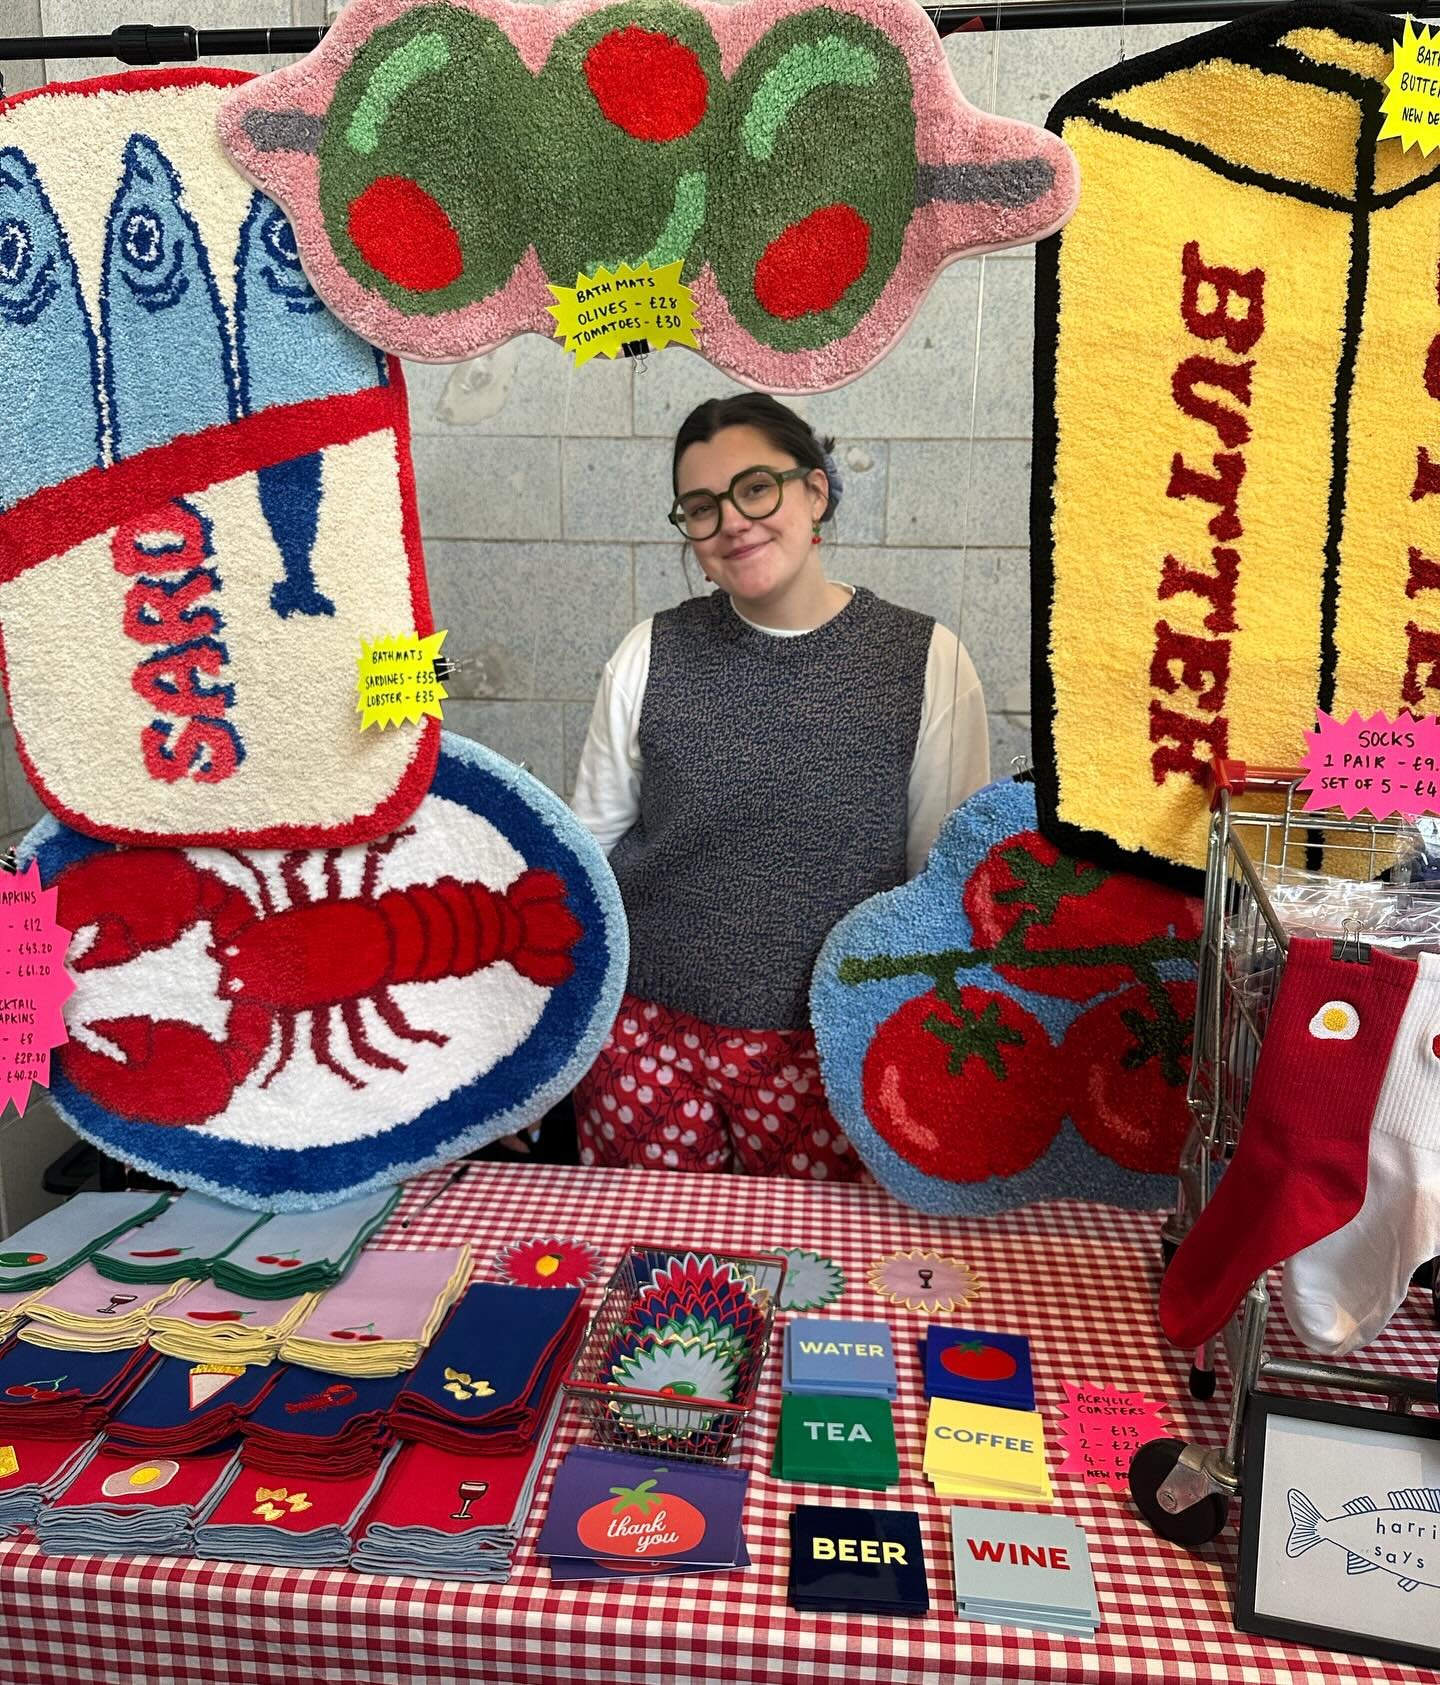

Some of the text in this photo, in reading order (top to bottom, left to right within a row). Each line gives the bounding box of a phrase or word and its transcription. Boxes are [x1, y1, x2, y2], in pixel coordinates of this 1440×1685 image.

[1402, 106, 1423, 124] NEW
[576, 277, 656, 304] BATH MATS
[577, 300, 628, 326] OLIVES
[650, 296, 678, 309] £28
[572, 317, 641, 346] TOMATOES
[656, 315, 681, 328] £30
[1148, 240, 1267, 787] BUTTER
[109, 496, 248, 784] SARD
[365, 673, 405, 690] SARDINES
[416, 671, 435, 685] £35
[367, 692, 402, 708] LOBSTER
[415, 690, 435, 704] £35
[1358, 730, 1415, 748] SOCKS
[1323, 754, 1334, 767] 1
[1343, 753, 1386, 769] PAIR
[1321, 777, 1349, 789] SET
[1355, 778, 1374, 790] OF
[1381, 778, 1391, 794] 5
[1414, 780, 1437, 797] £4
[0, 891, 37, 906] APKINS
[24, 918, 42, 932] £12
[18, 942, 53, 955] £43.20
[18, 965, 51, 977] £61.20
[20, 1033, 34, 1045] £8
[800, 1340, 885, 1357] WATER
[1077, 1393, 1133, 1406] ACRYLIC
[1078, 1404, 1146, 1416] COASTERS
[803, 1420, 873, 1443] TEA
[1080, 1423, 1085, 1434] 1
[1111, 1425, 1139, 1437] £13
[934, 1426, 1034, 1454] COFFEE
[1080, 1439, 1091, 1449] 2
[1084, 1454, 1094, 1466] 4
[1086, 1469, 1110, 1478] NEW
[607, 1510, 667, 1537] thank
[635, 1530, 680, 1553] you
[812, 1536, 908, 1566] BEER
[966, 1538, 1071, 1570] WINE
[1374, 1546, 1425, 1569] says
